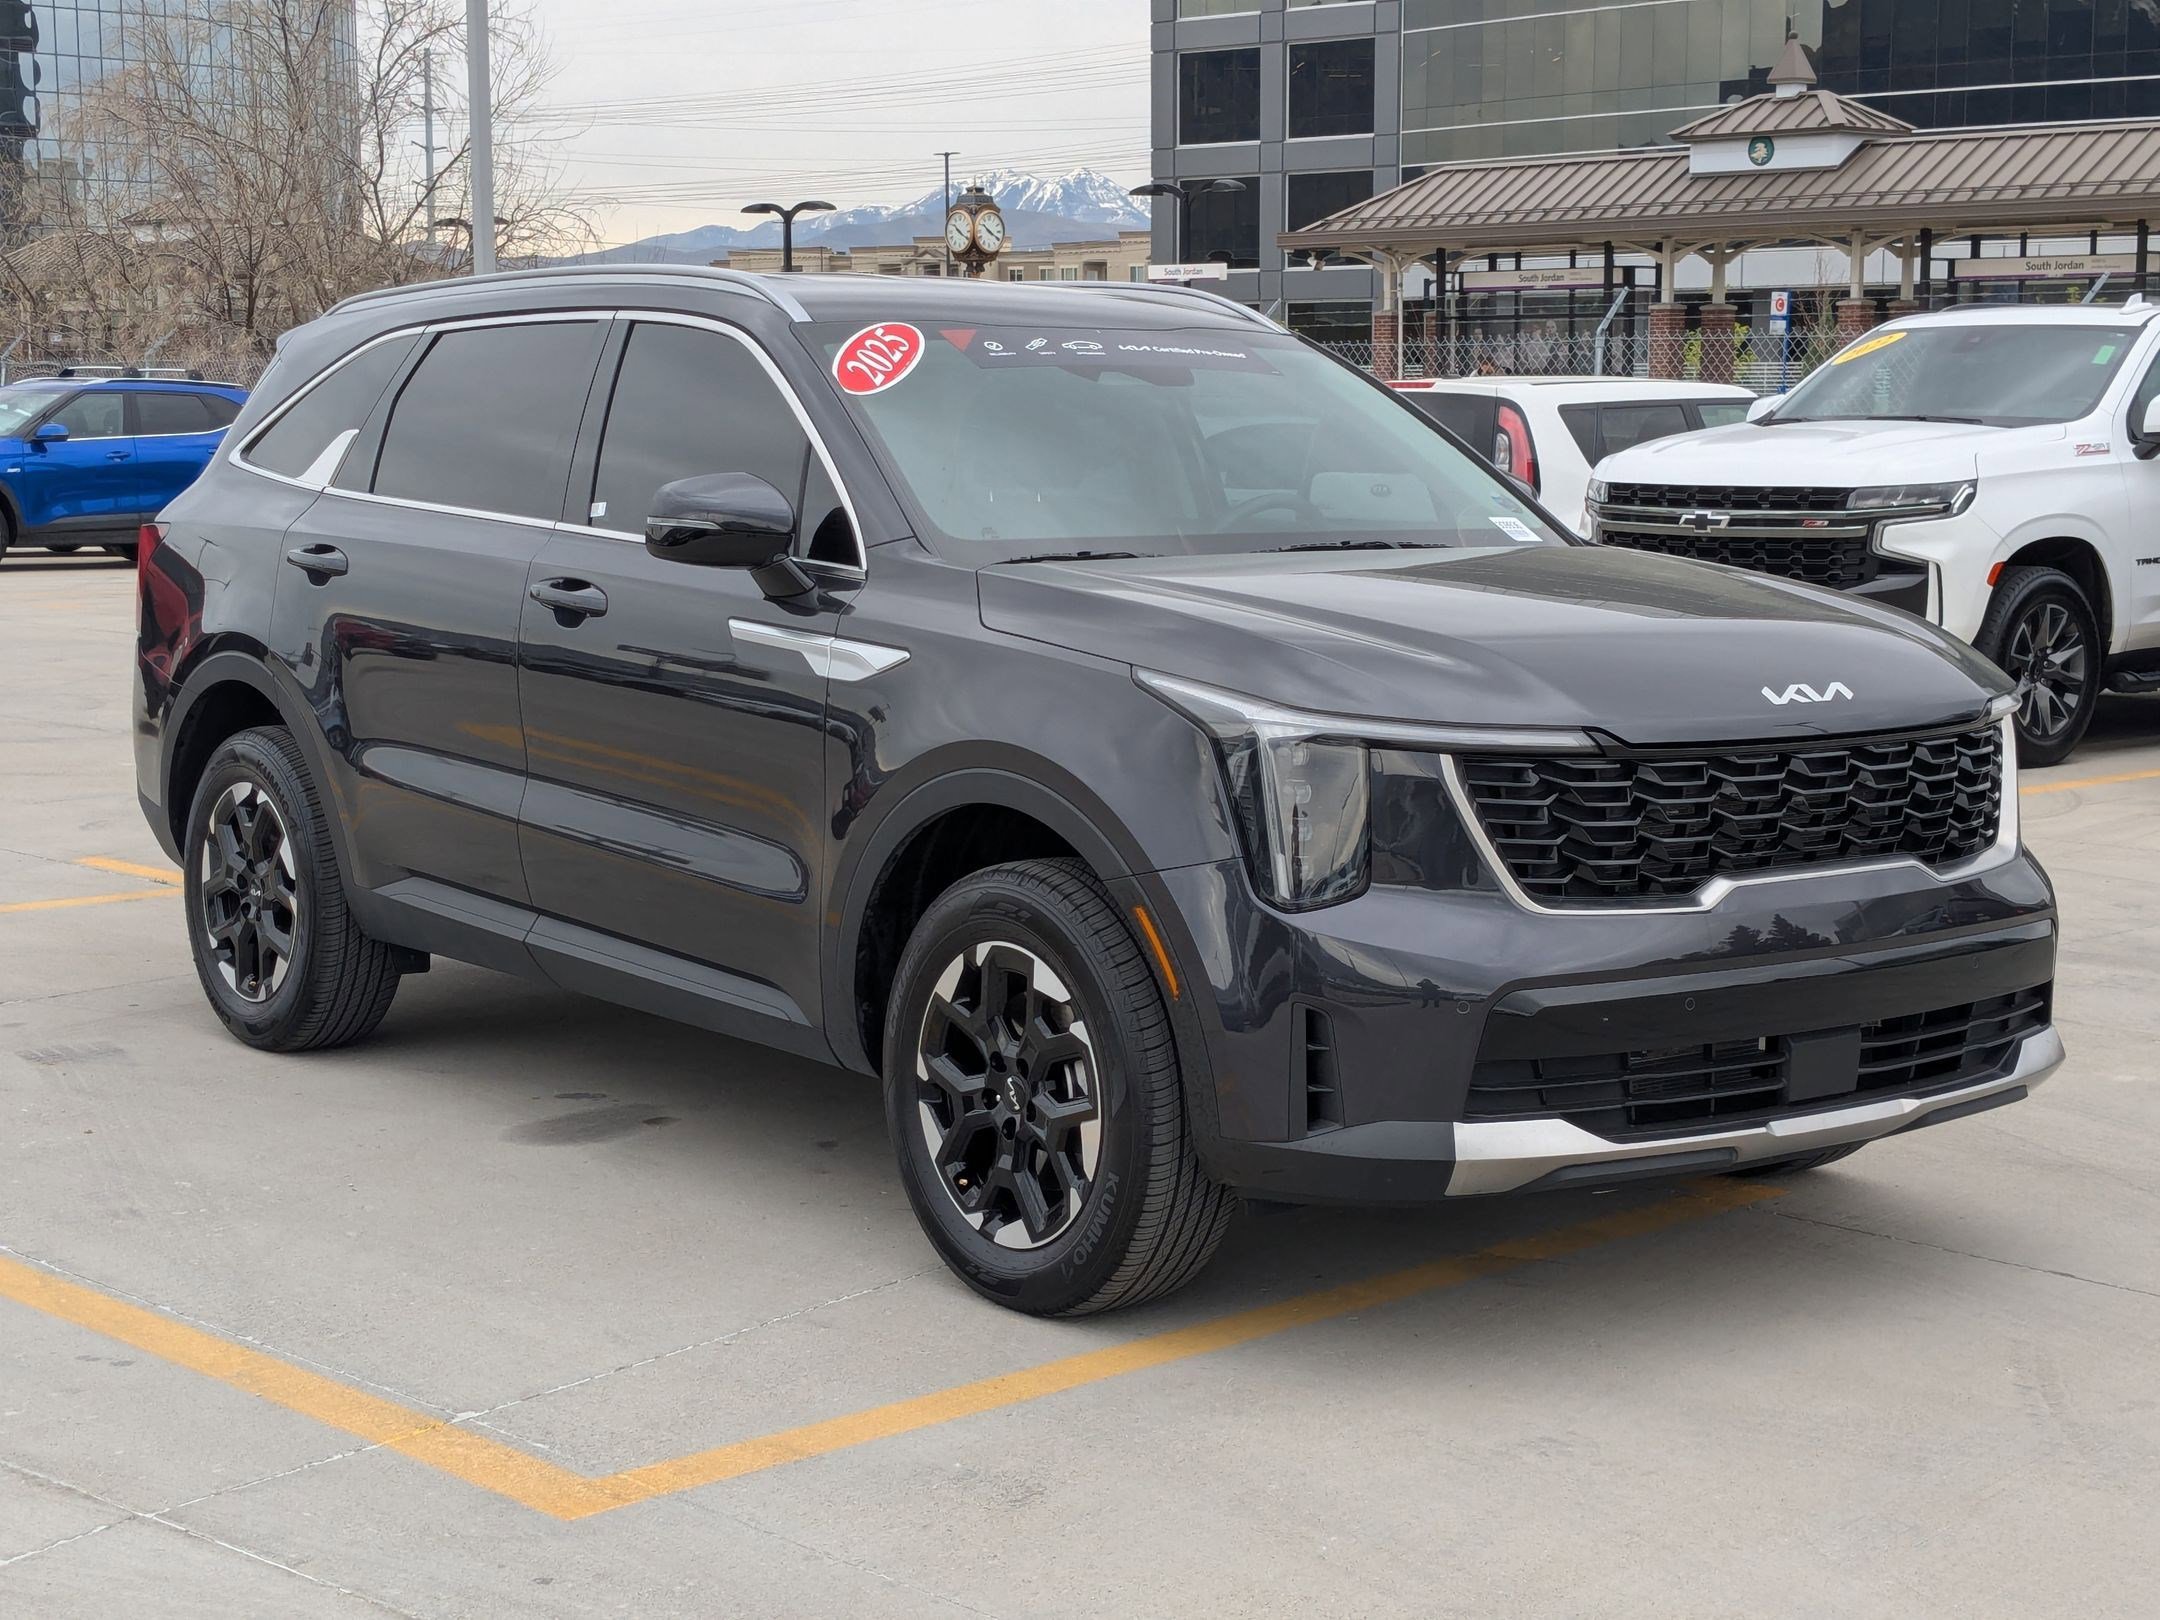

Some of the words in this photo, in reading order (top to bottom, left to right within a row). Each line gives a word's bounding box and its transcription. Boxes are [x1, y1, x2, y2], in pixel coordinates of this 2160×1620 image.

[1164, 268, 1181, 276] South
[1183, 267, 1203, 275] Jordan
[1518, 273, 1540, 283] South
[1540, 272, 1565, 282] Jordan
[2025, 261, 2051, 271] South
[2053, 260, 2085, 271] Jordan
[846, 327, 910, 387] 2025
[1761, 681, 1854, 705] KIA
[256, 759, 290, 816] KUMHO
[1073, 1172, 1120, 1265] KUMHO
